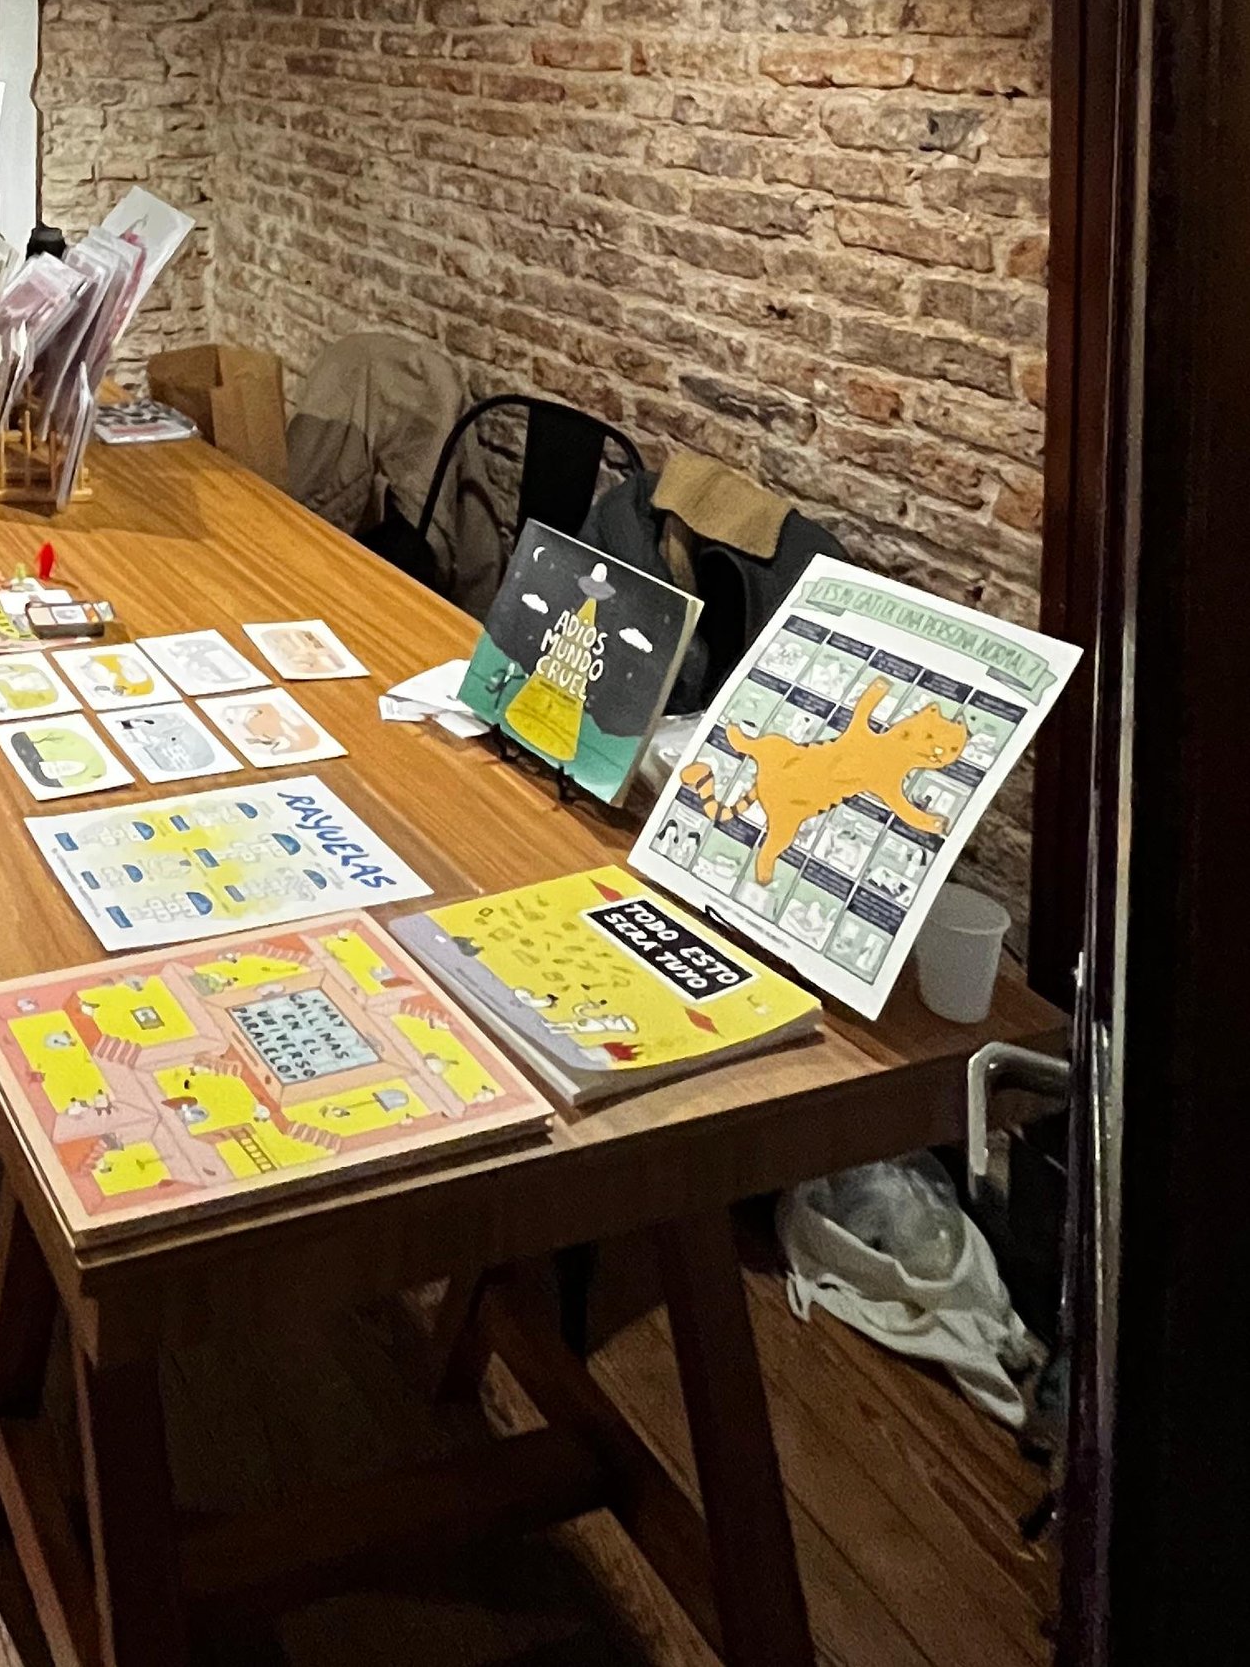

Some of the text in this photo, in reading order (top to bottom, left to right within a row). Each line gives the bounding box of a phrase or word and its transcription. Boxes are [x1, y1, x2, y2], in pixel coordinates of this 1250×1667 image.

[535, 655, 589, 701] CRUEL
[540, 628, 605, 682] MUNDO
[276, 792, 397, 888] RAYUELAS
[623, 903, 679, 941] TODO
[679, 946, 740, 984] ESTO
[655, 951, 708, 989] TUYO
[256, 1010, 317, 1078] UNIVERSO
[281, 1014, 322, 1055] EN EL
[288, 994, 350, 1060] GALLINAS
